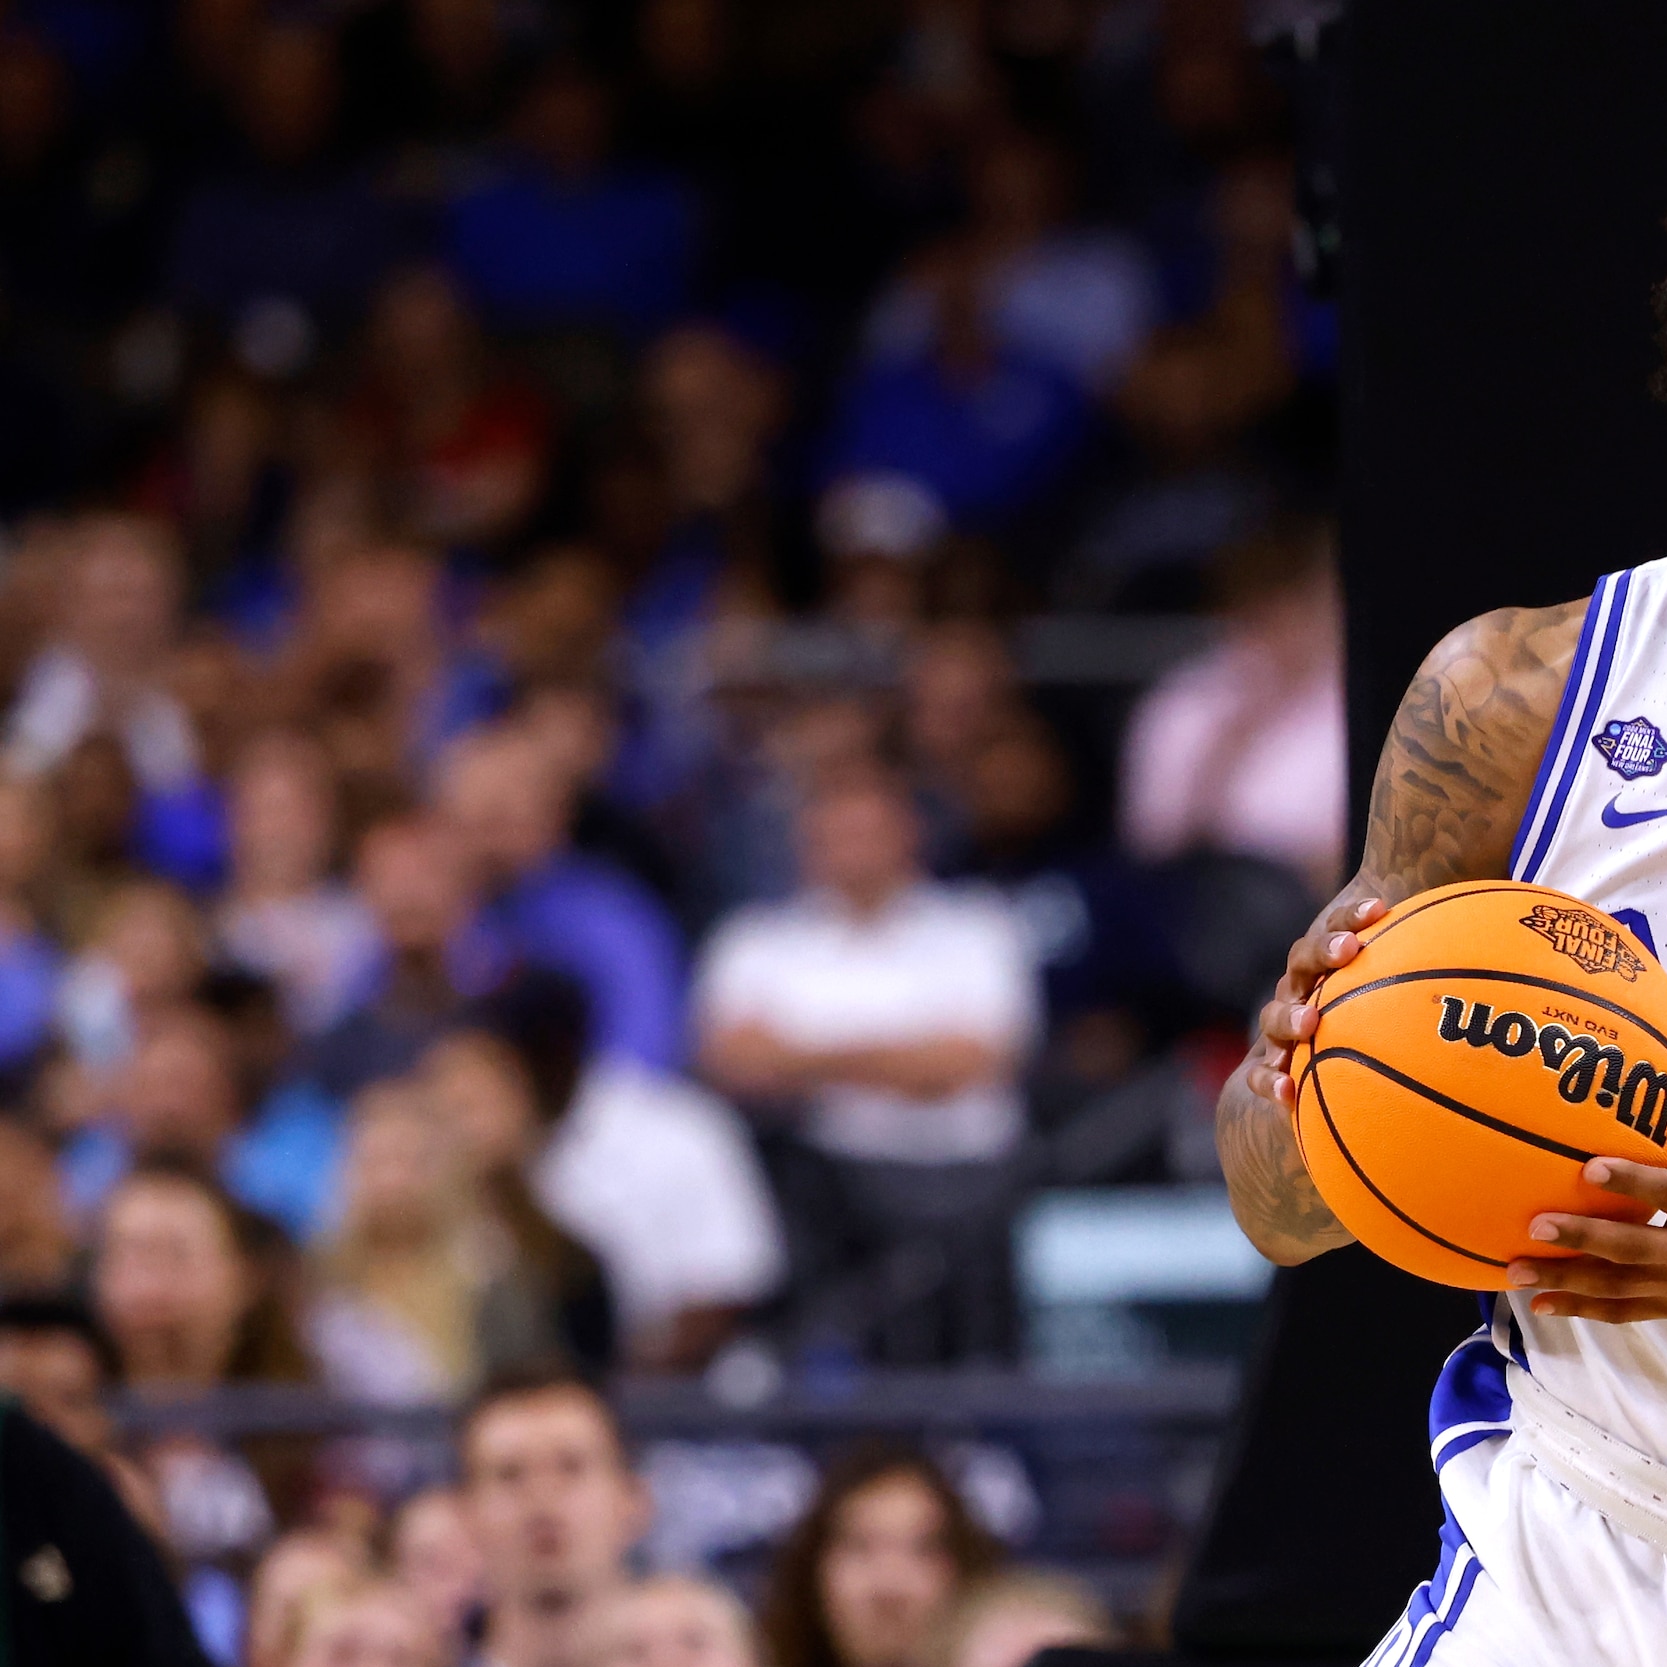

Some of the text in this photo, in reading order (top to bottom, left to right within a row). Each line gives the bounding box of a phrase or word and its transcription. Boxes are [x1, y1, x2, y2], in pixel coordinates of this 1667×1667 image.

[1613, 744, 1652, 763] FOUR
[1619, 731, 1655, 750] FINAL
[1554, 917, 1619, 952] FOUR
[1554, 932, 1618, 970] FINAL
[1542, 1005, 1619, 1041] EVO NXT
